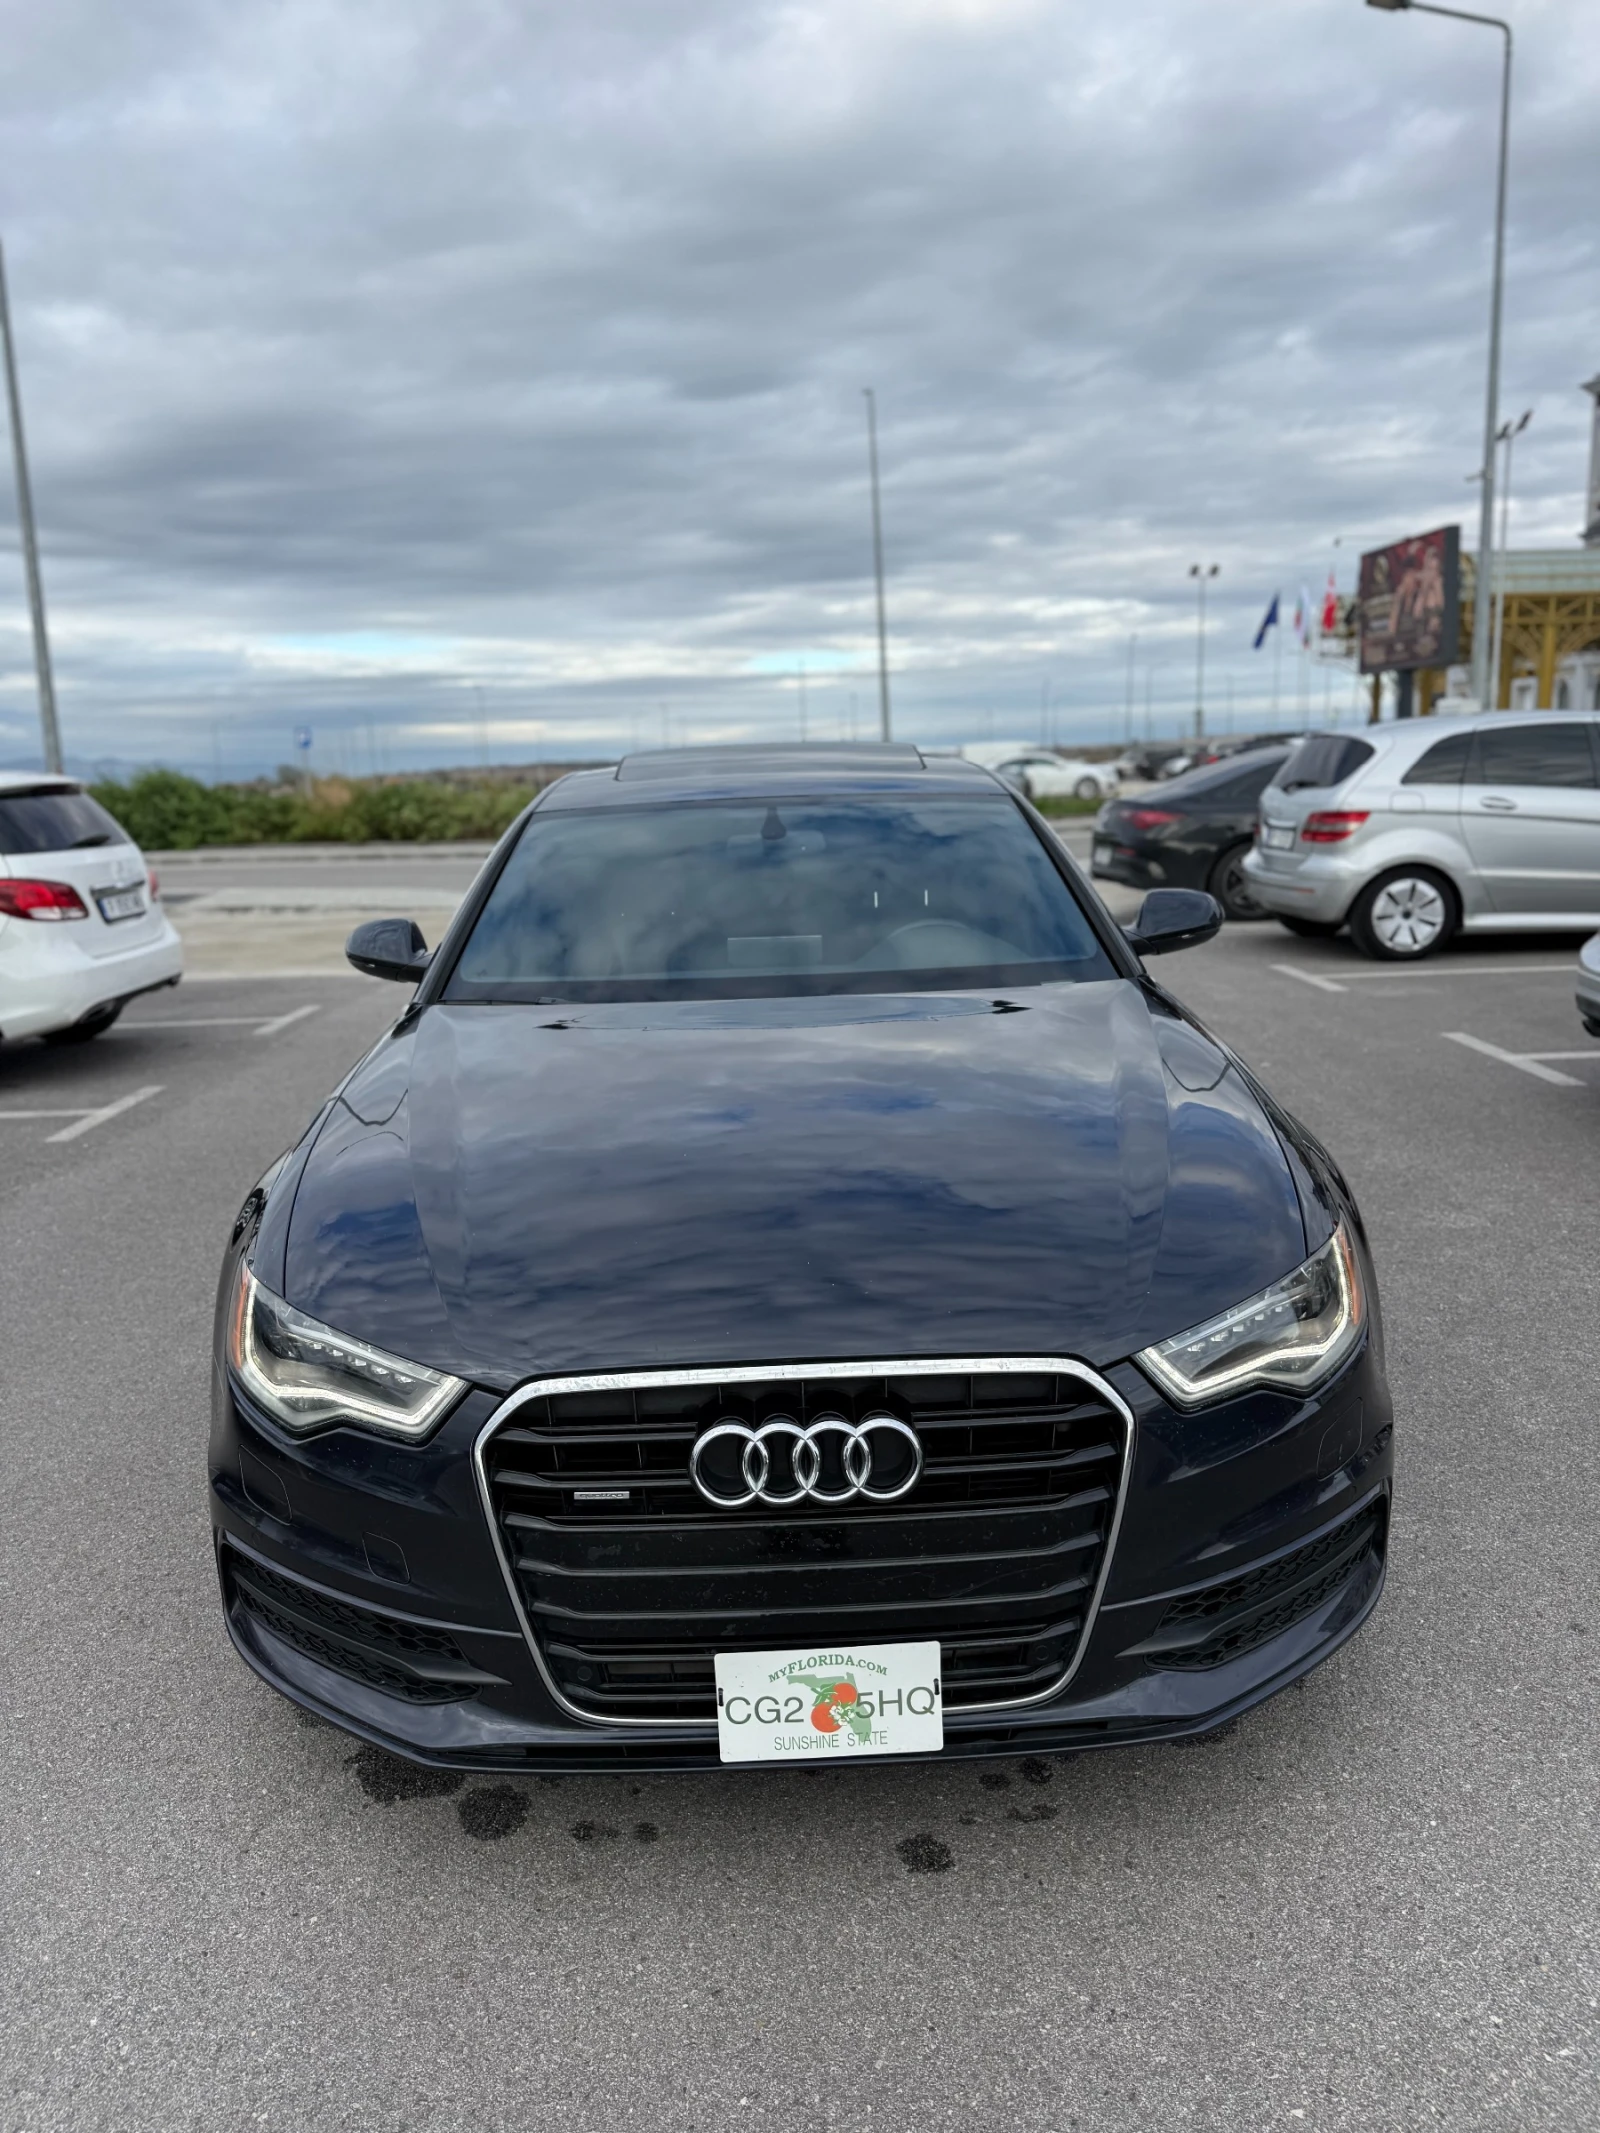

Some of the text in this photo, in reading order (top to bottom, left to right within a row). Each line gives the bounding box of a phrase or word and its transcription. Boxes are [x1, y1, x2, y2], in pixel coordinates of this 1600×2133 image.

[768, 1654, 888, 1683] MYFLORIDA.COM
[725, 1686, 936, 1725] CG2 5HQ
[774, 1730, 888, 1751] SUNSHINE STATE
